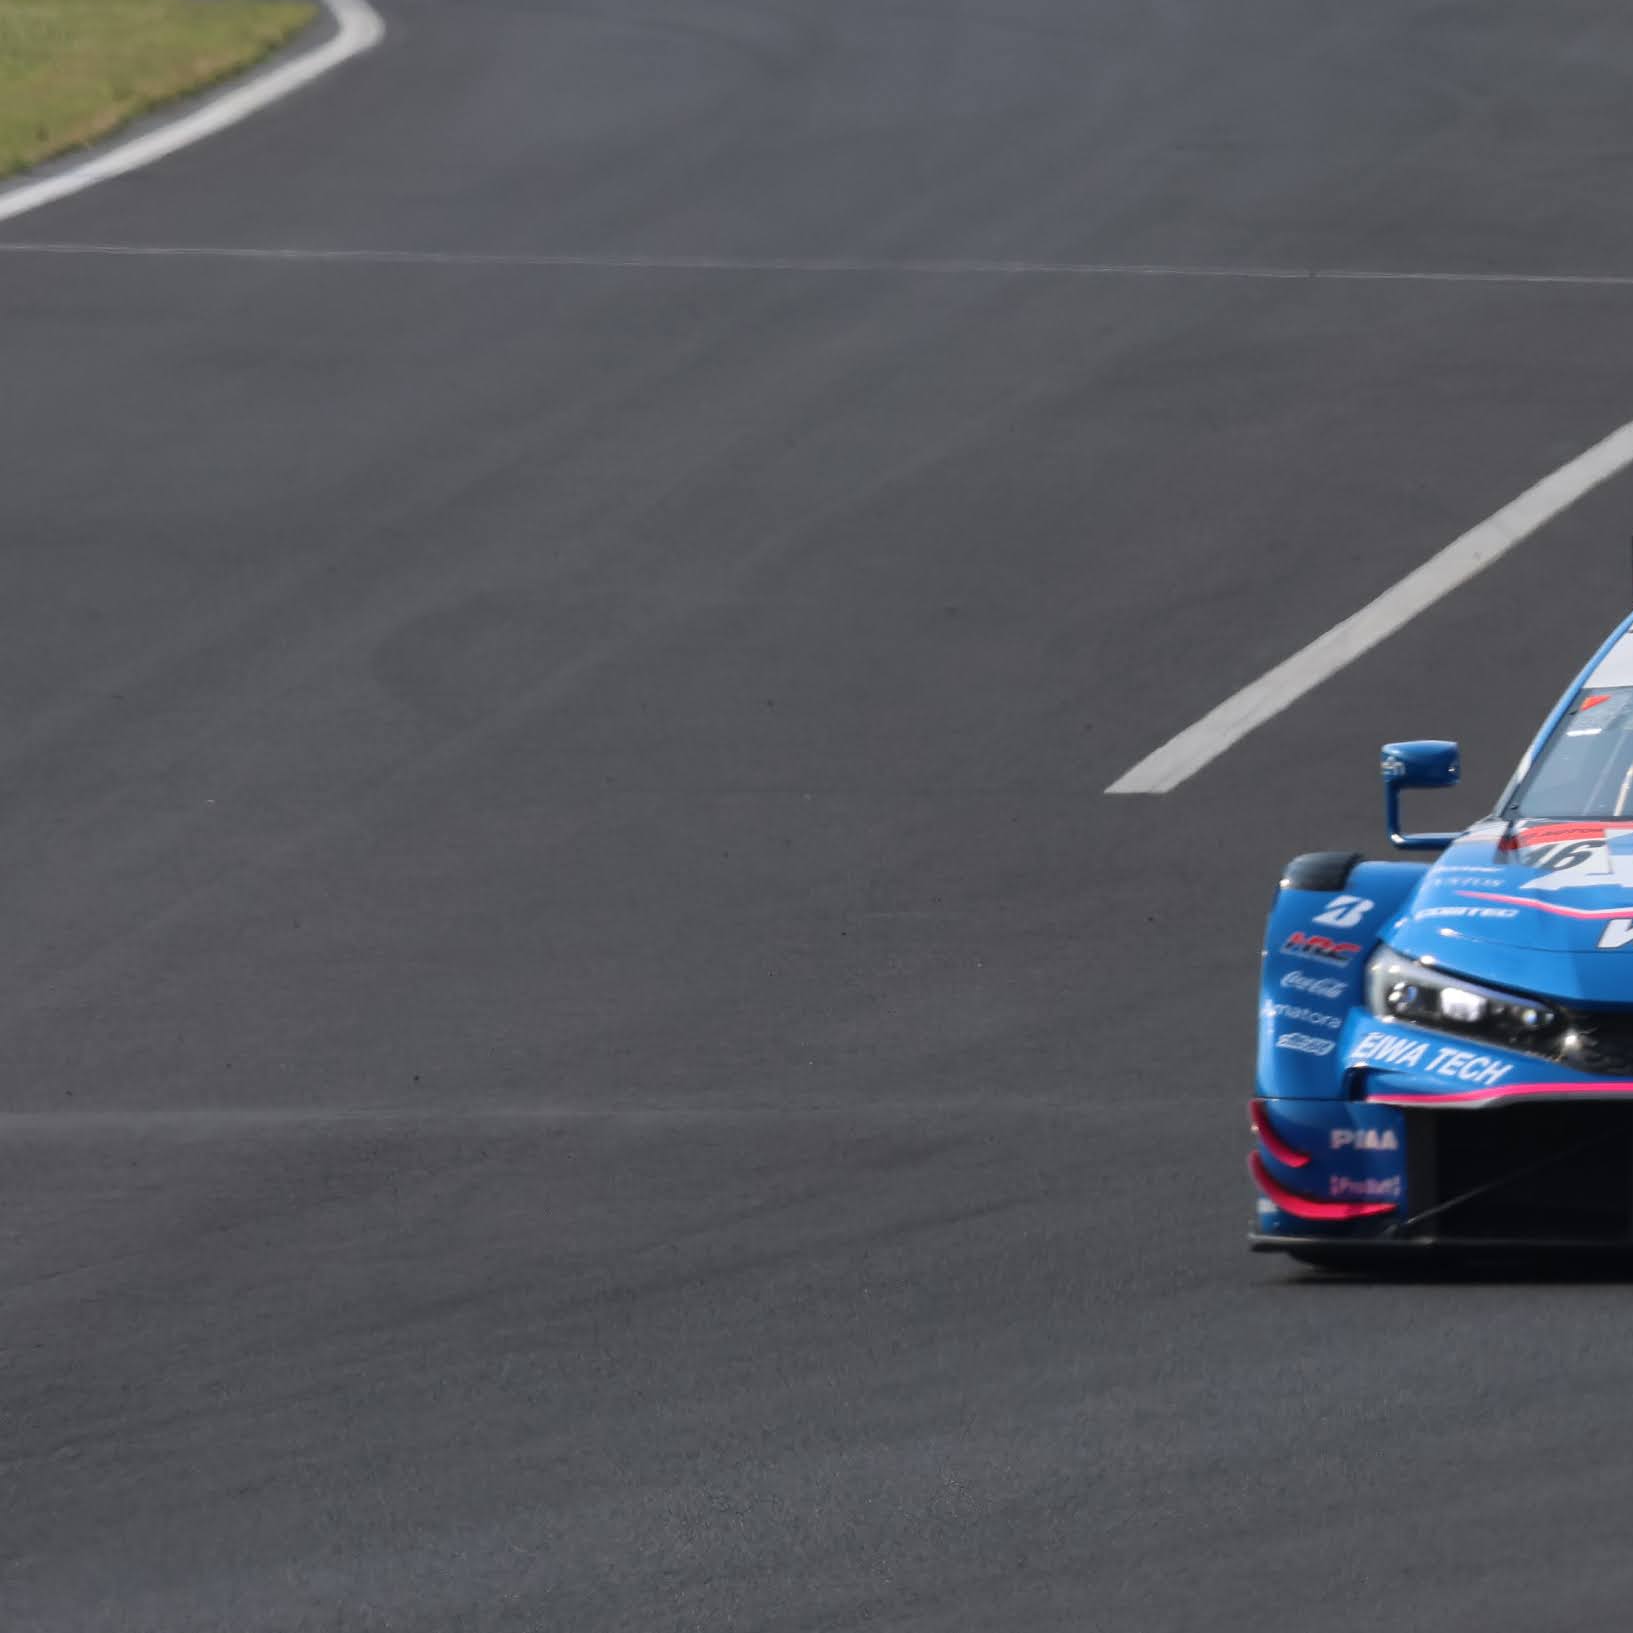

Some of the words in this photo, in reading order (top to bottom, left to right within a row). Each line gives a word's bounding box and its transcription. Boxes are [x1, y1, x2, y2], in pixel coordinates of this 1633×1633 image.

[1350, 1031, 1430, 1068] EIWA
[1424, 1047, 1515, 1085] TECH
[1330, 1129, 1398, 1150] PIAA
